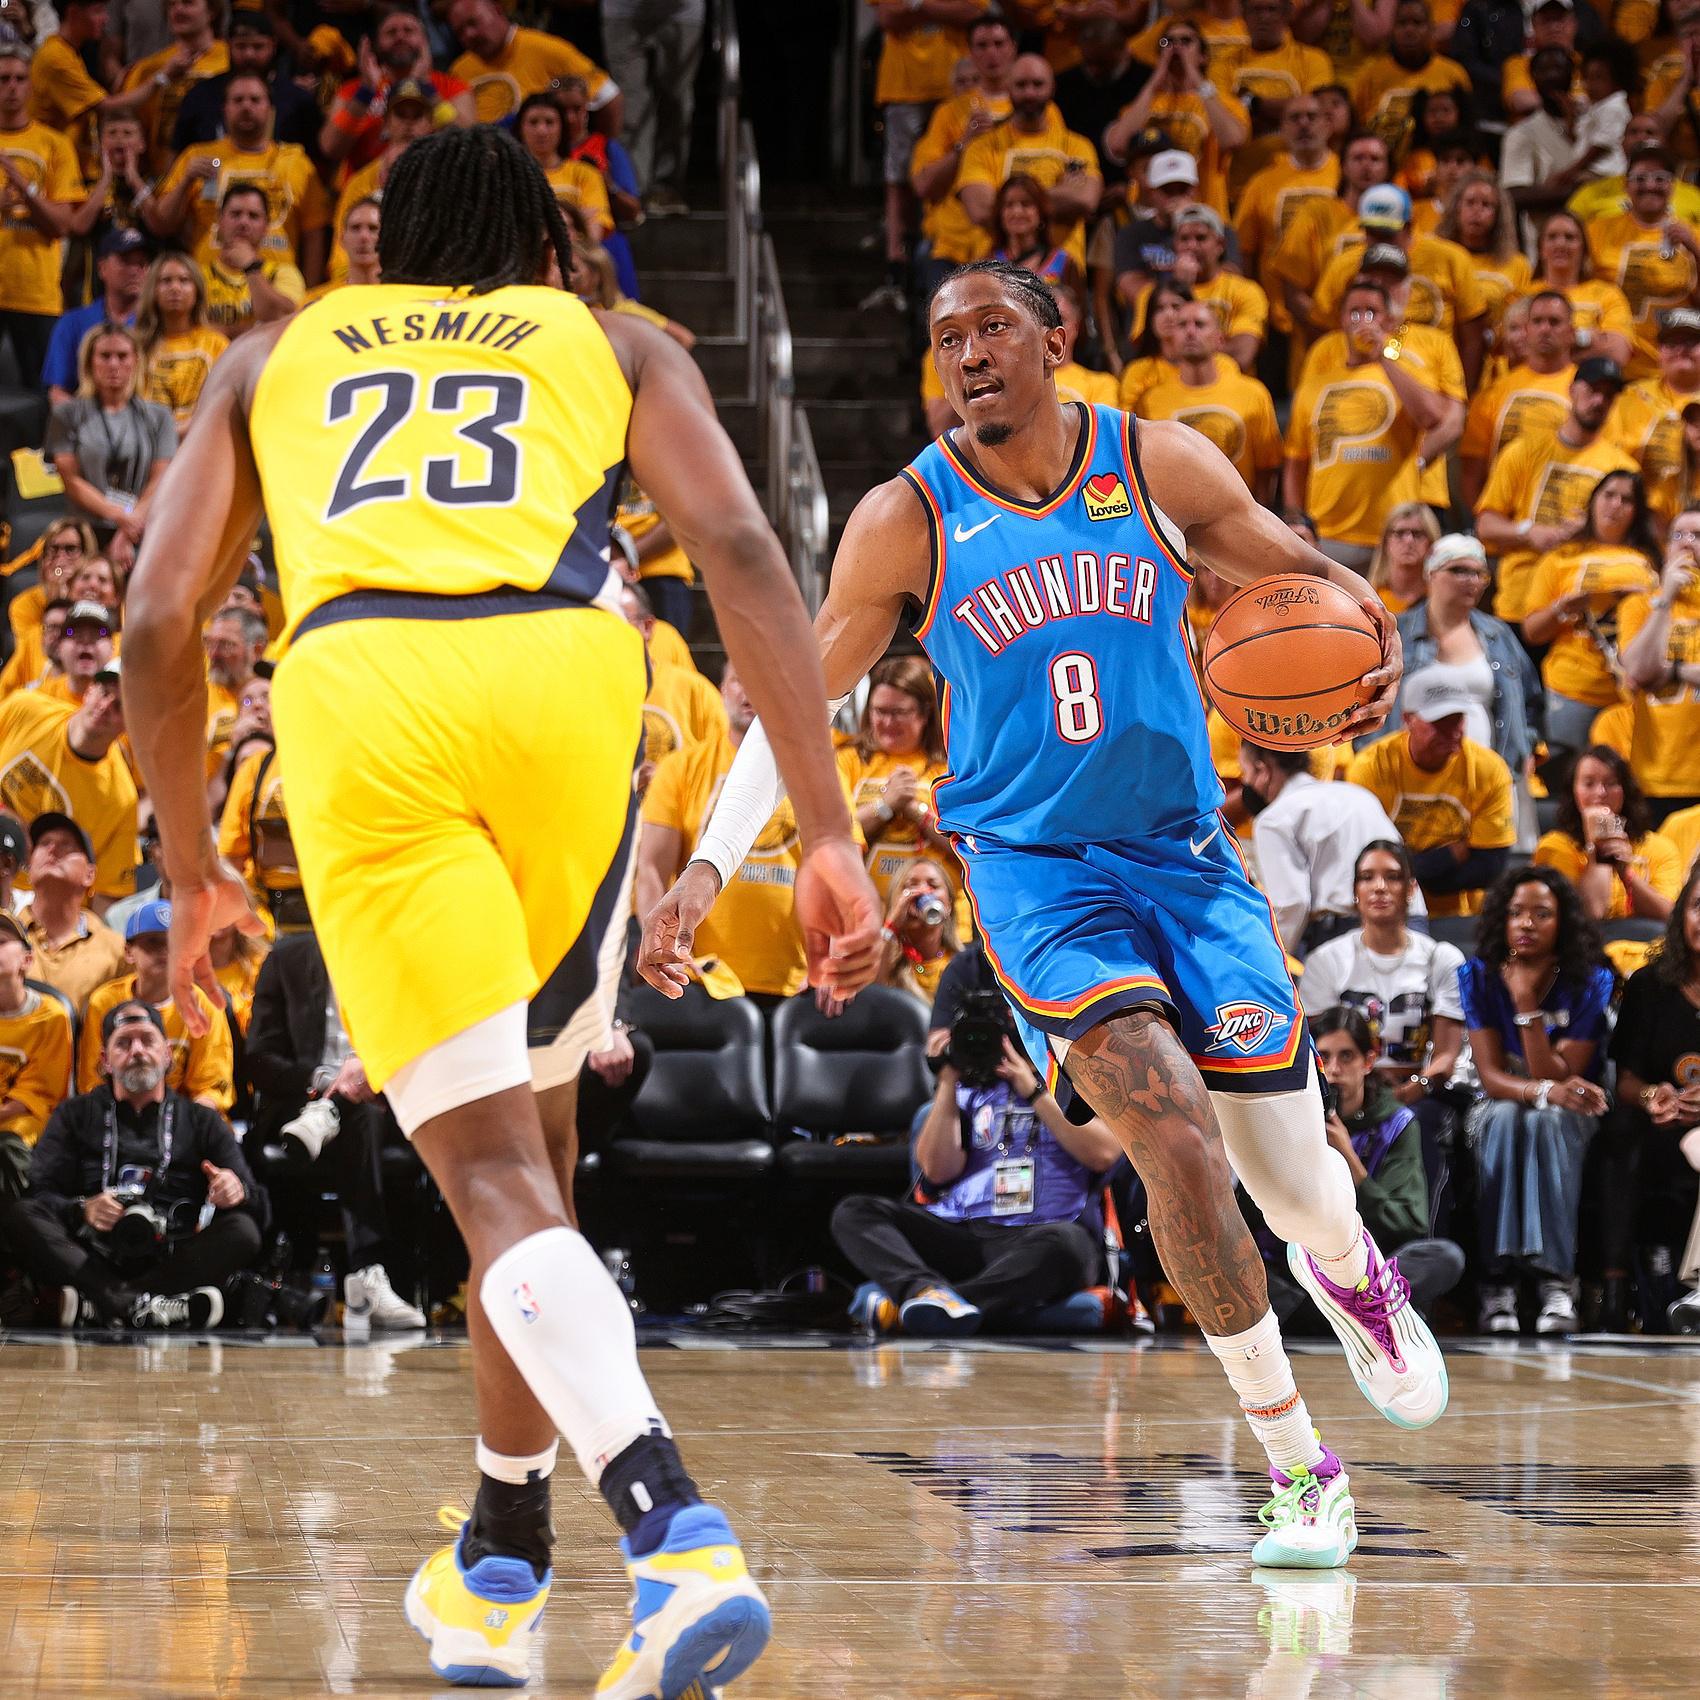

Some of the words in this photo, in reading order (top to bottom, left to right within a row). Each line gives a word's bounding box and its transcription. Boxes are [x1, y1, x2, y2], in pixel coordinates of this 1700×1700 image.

[331, 310, 542, 354] NESMITH
[323, 369, 527, 522] 23
[951, 551, 1158, 658] THUNDER
[1048, 650, 1105, 745] 8
[1215, 1011, 1264, 1041] OKC
